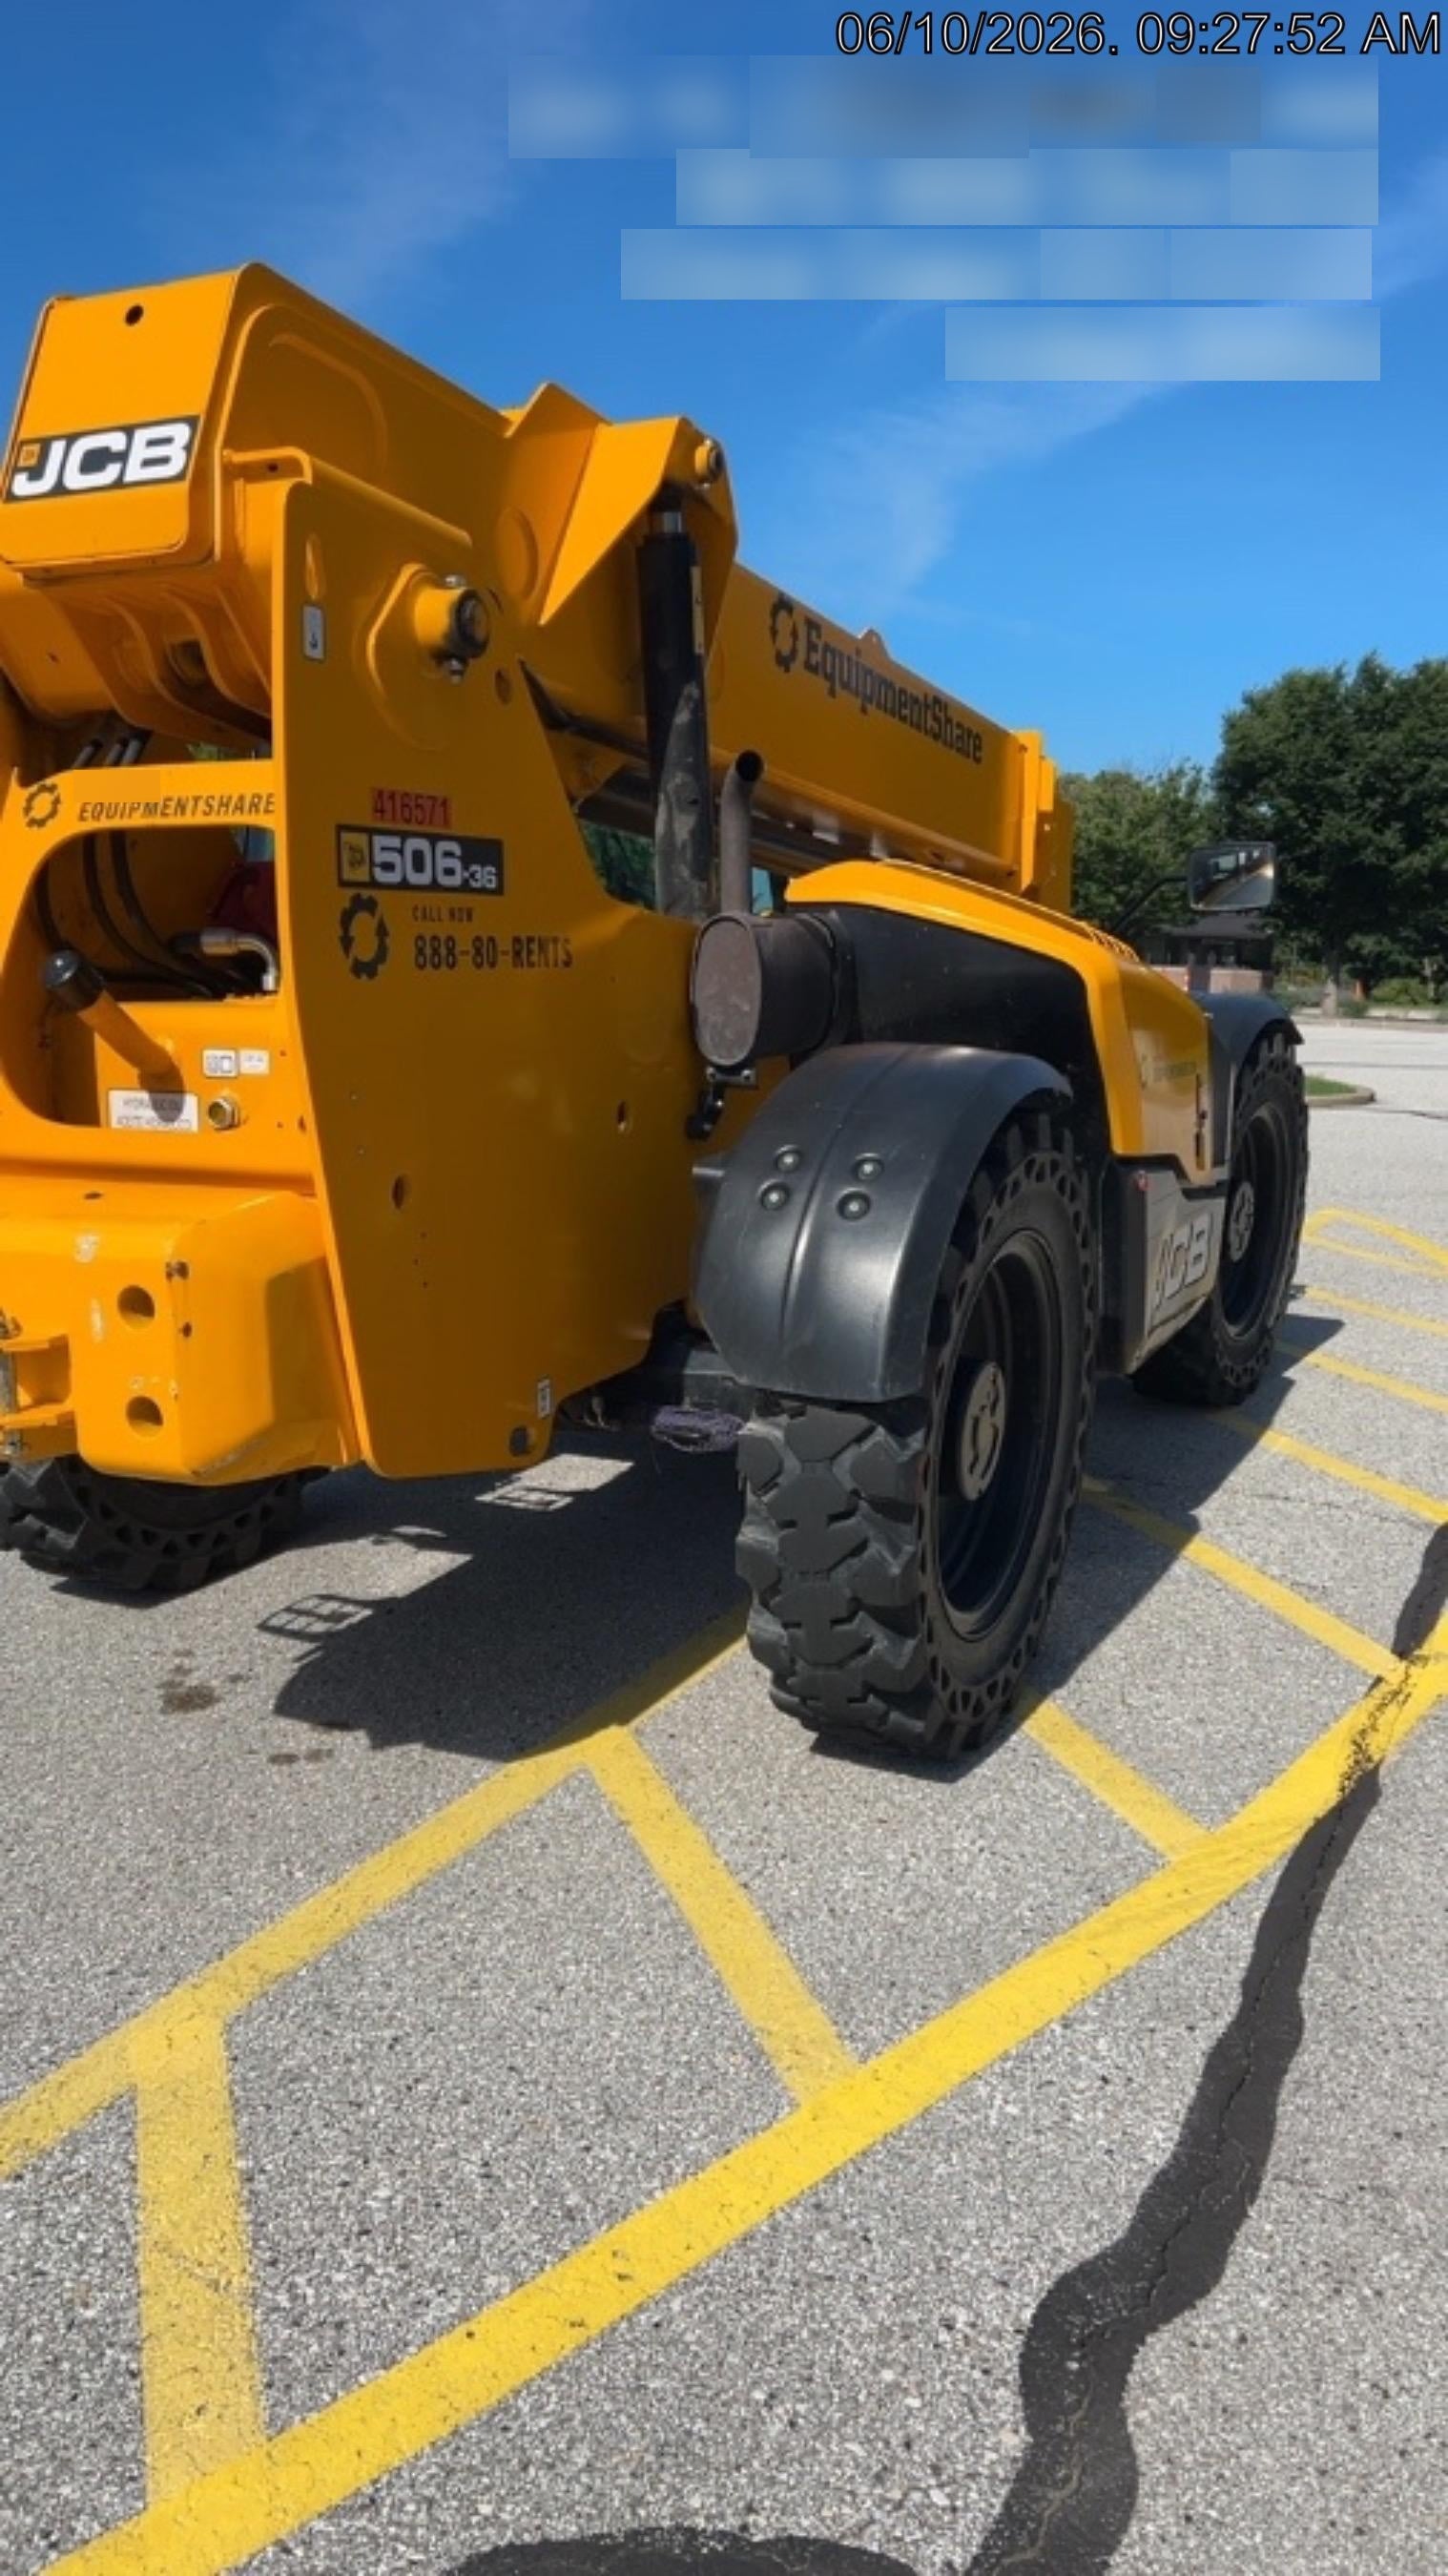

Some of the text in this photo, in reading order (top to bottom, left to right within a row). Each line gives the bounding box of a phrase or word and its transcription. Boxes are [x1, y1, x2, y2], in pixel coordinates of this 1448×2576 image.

[10, 422, 192, 497] JCB
[803, 615, 983, 764] EquipmentShare
[77, 792, 276, 822] EQUIPMENTSHARE
[373, 789, 449, 825] 416571
[412, 905, 444, 923] CALL
[414, 934, 572, 970] 888-80-RENTS
